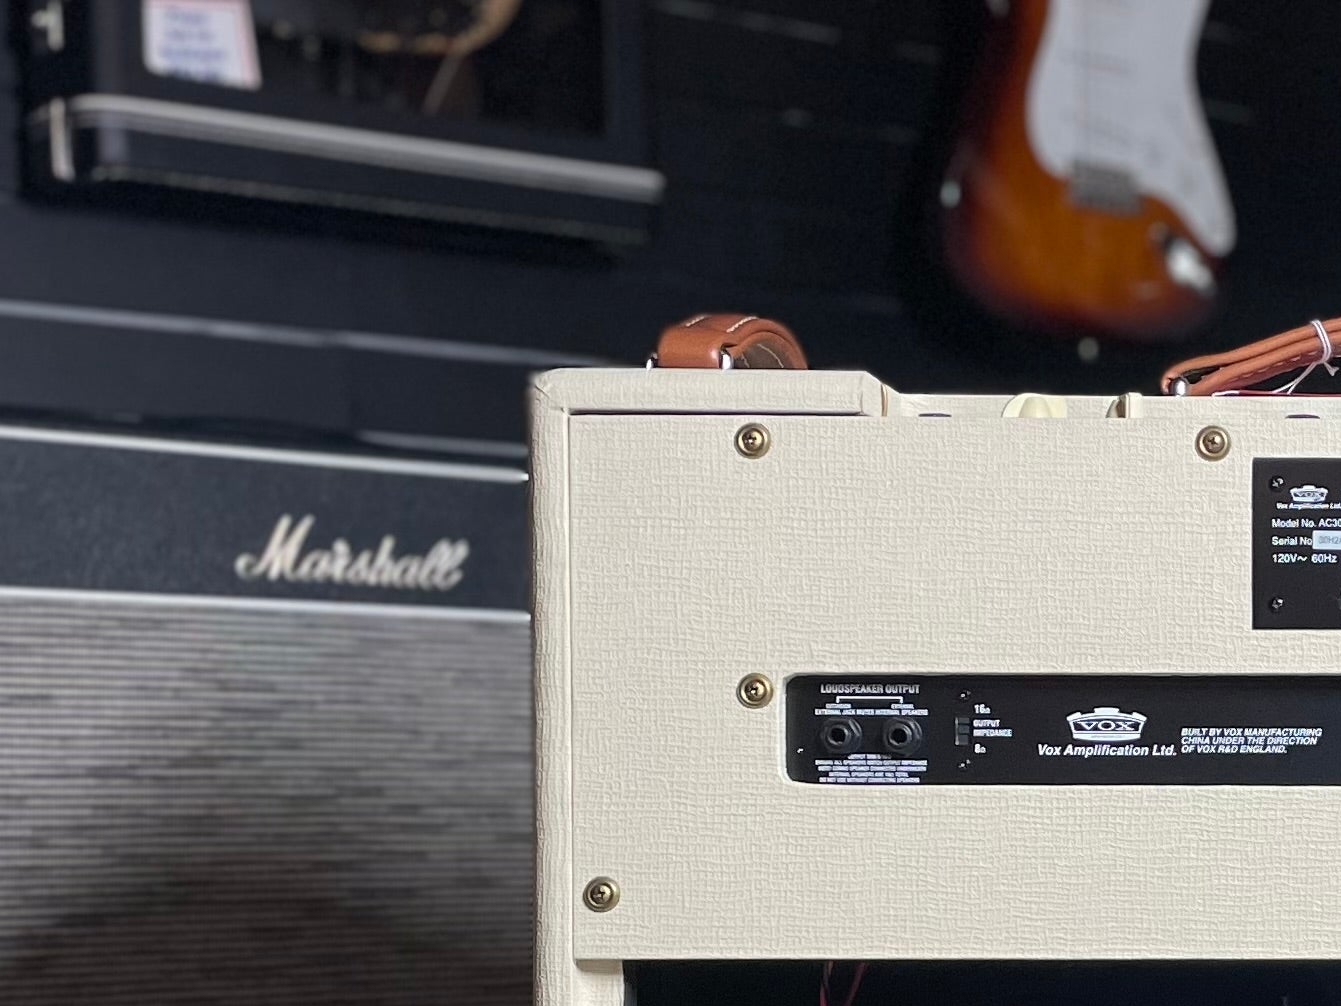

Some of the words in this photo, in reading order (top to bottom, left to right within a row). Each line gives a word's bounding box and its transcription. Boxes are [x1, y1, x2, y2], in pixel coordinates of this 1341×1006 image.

[1271, 518, 1299, 528] Model
[1301, 518, 1316, 528] No.
[1272, 536, 1298, 545] Serial
[234, 513, 470, 590] Marshall
[1311, 553, 1337, 563] 60Hz
[820, 684, 884, 694] LOUDSPEAKER
[885, 684, 920, 694] OUTPUT
[973, 719, 1000, 727] OUTPUT
[1076, 720, 1135, 731] VOX
[1181, 728, 1208, 736] BUILT
[1209, 728, 1224, 736] BY
[1223, 728, 1243, 736] VOX
[1244, 728, 1322, 736] MANUFACTURING
[1181, 737, 1210, 745] CHINA
[1212, 737, 1245, 745] UNDER
[1247, 737, 1265, 745] THE
[1266, 737, 1318, 745] DIRECTION
[1038, 744, 1061, 755] Vox
[1063, 744, 1149, 758] Amplification
[1152, 744, 1177, 756] Ltd.
[1181, 745, 1195, 753] OF
[1197, 745, 1216, 753] VOX
[1217, 745, 1238, 753] R&D
[1240, 745, 1287, 753] ENGLAND.
